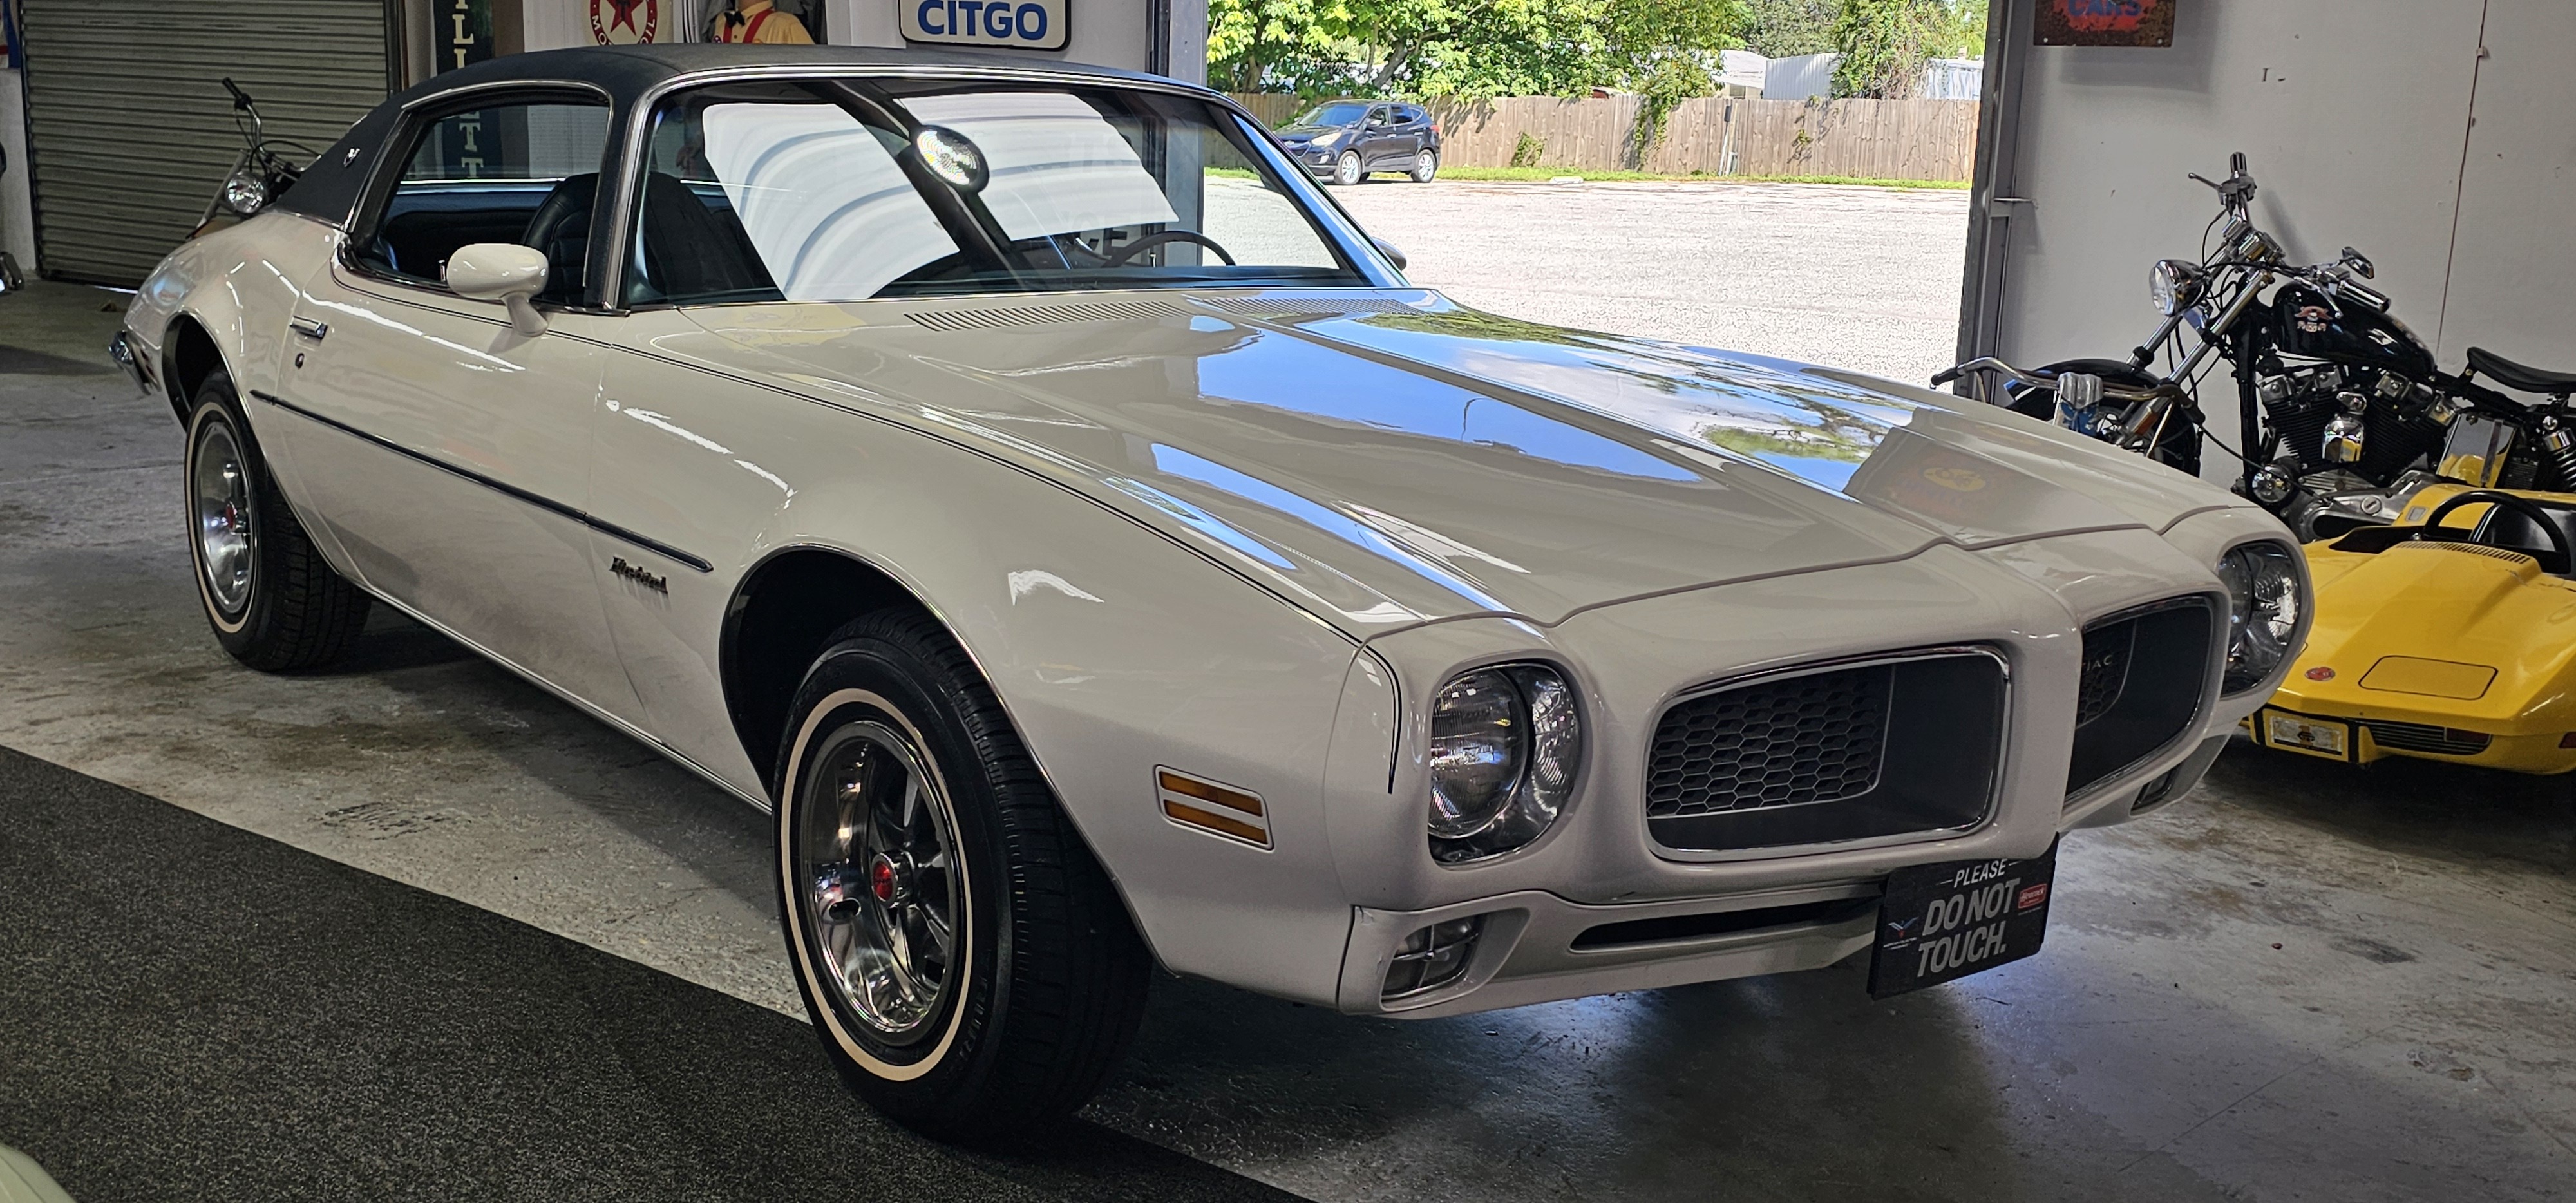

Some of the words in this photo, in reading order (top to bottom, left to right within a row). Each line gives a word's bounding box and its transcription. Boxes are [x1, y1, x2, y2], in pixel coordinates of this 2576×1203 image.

[592, 15, 612, 45] MO
[918, 0, 1048, 41] CITGO
[2083, 654, 2113, 671] IAC
[1953, 858, 2008, 888] PLEASE
[1922, 894, 1964, 936] DO
[1965, 877, 2021, 925] NOT
[1917, 920, 2007, 977] TOUCH.
